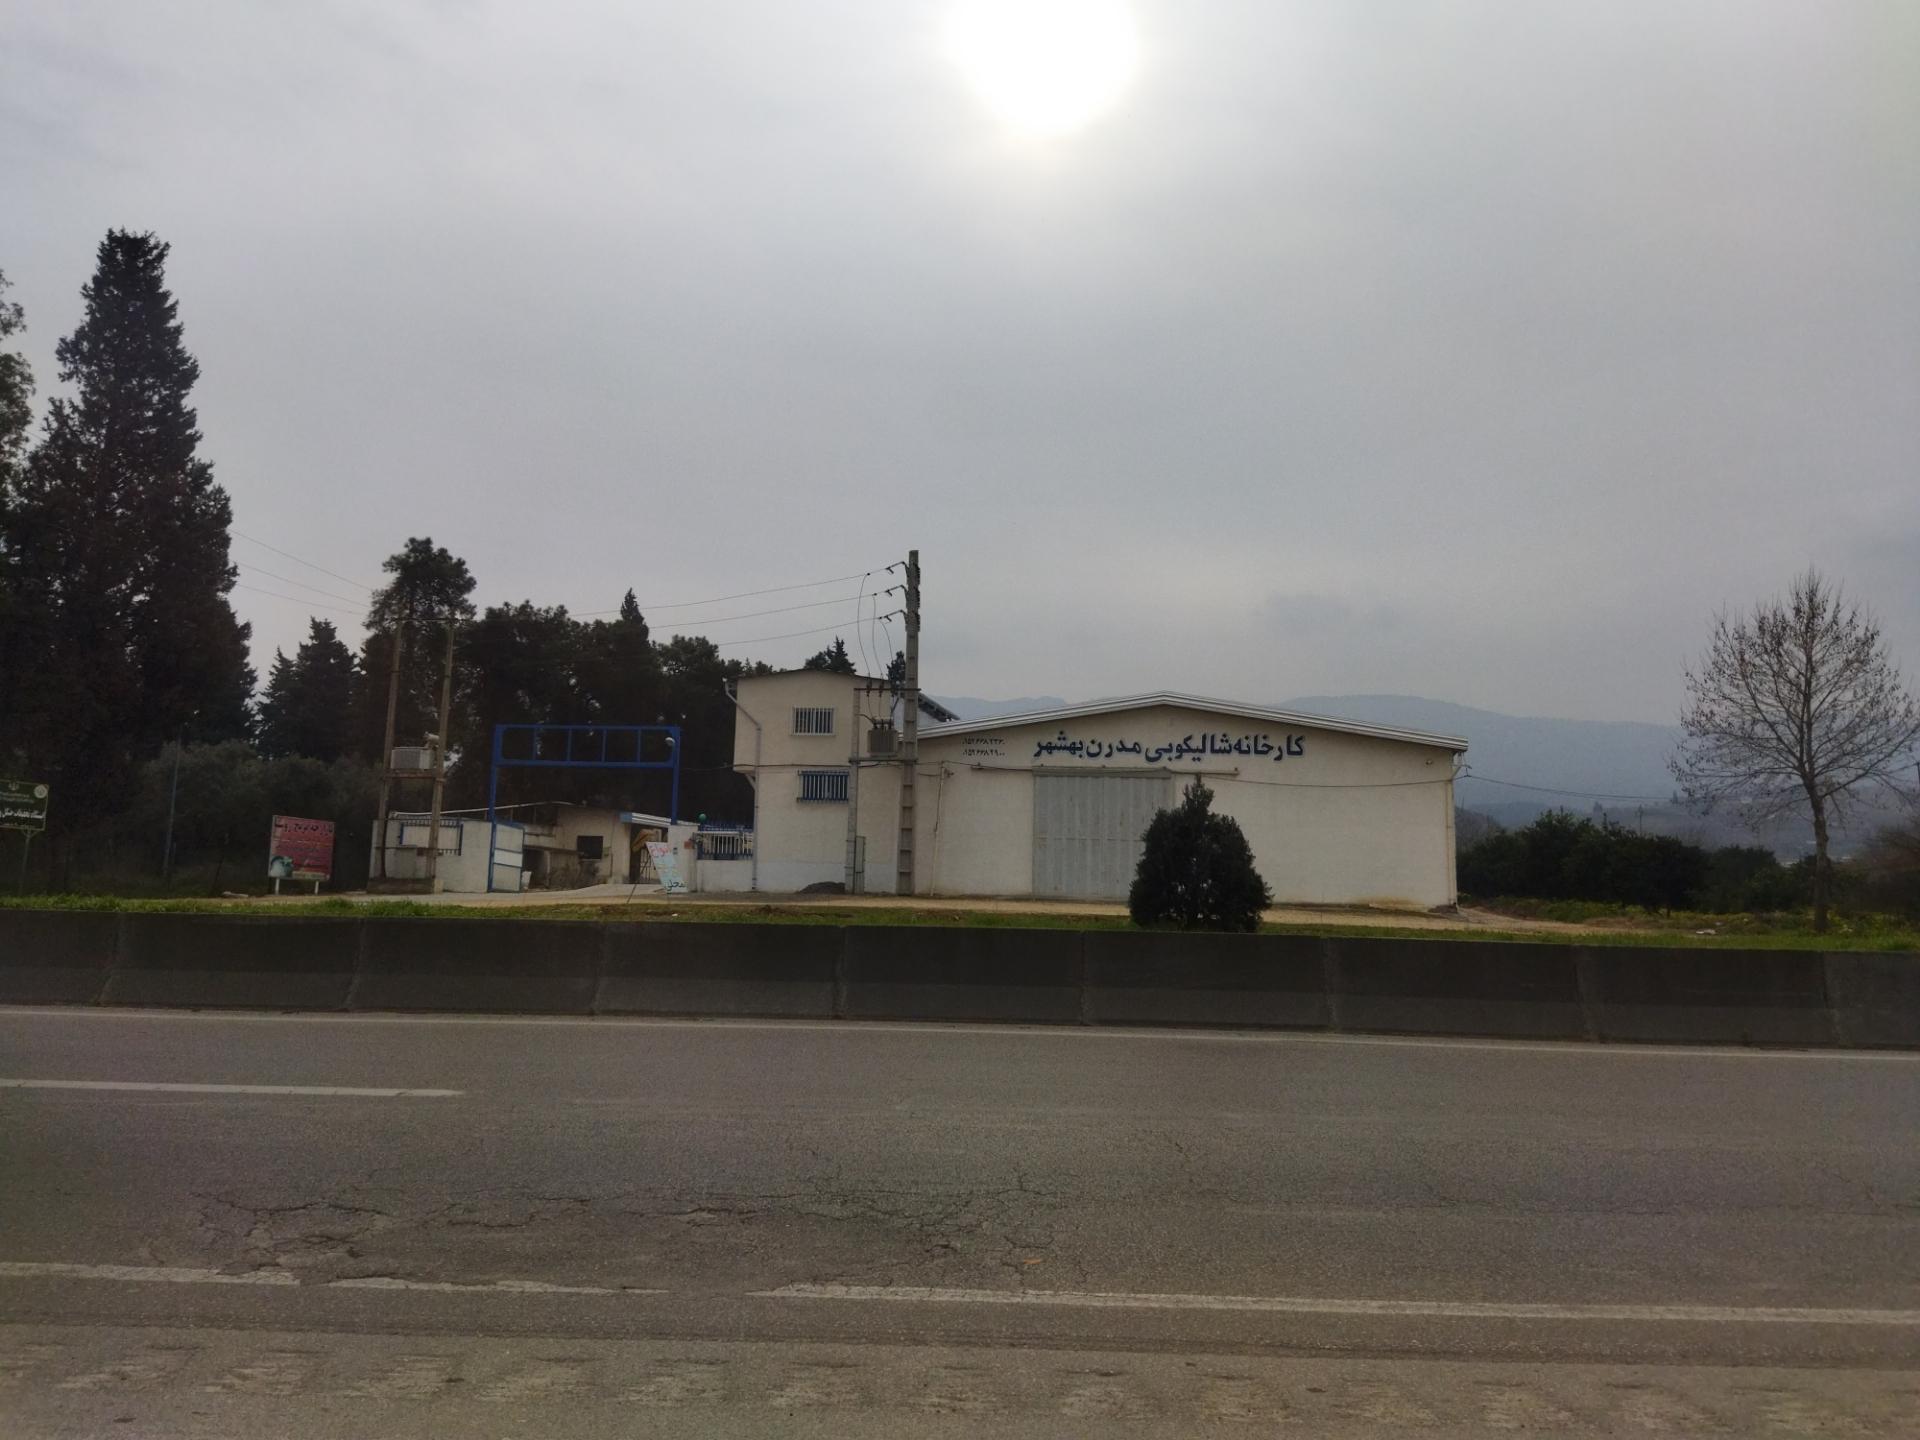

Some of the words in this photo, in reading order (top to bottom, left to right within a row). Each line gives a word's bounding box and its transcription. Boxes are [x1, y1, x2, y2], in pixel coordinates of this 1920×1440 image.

[1034, 731, 1083, 758] بهشهر
[1086, 737, 1141, 758] مدرن
[1145, 733, 1231, 762] شالیکوبی
[1233, 733, 1304, 761] کارخانه
